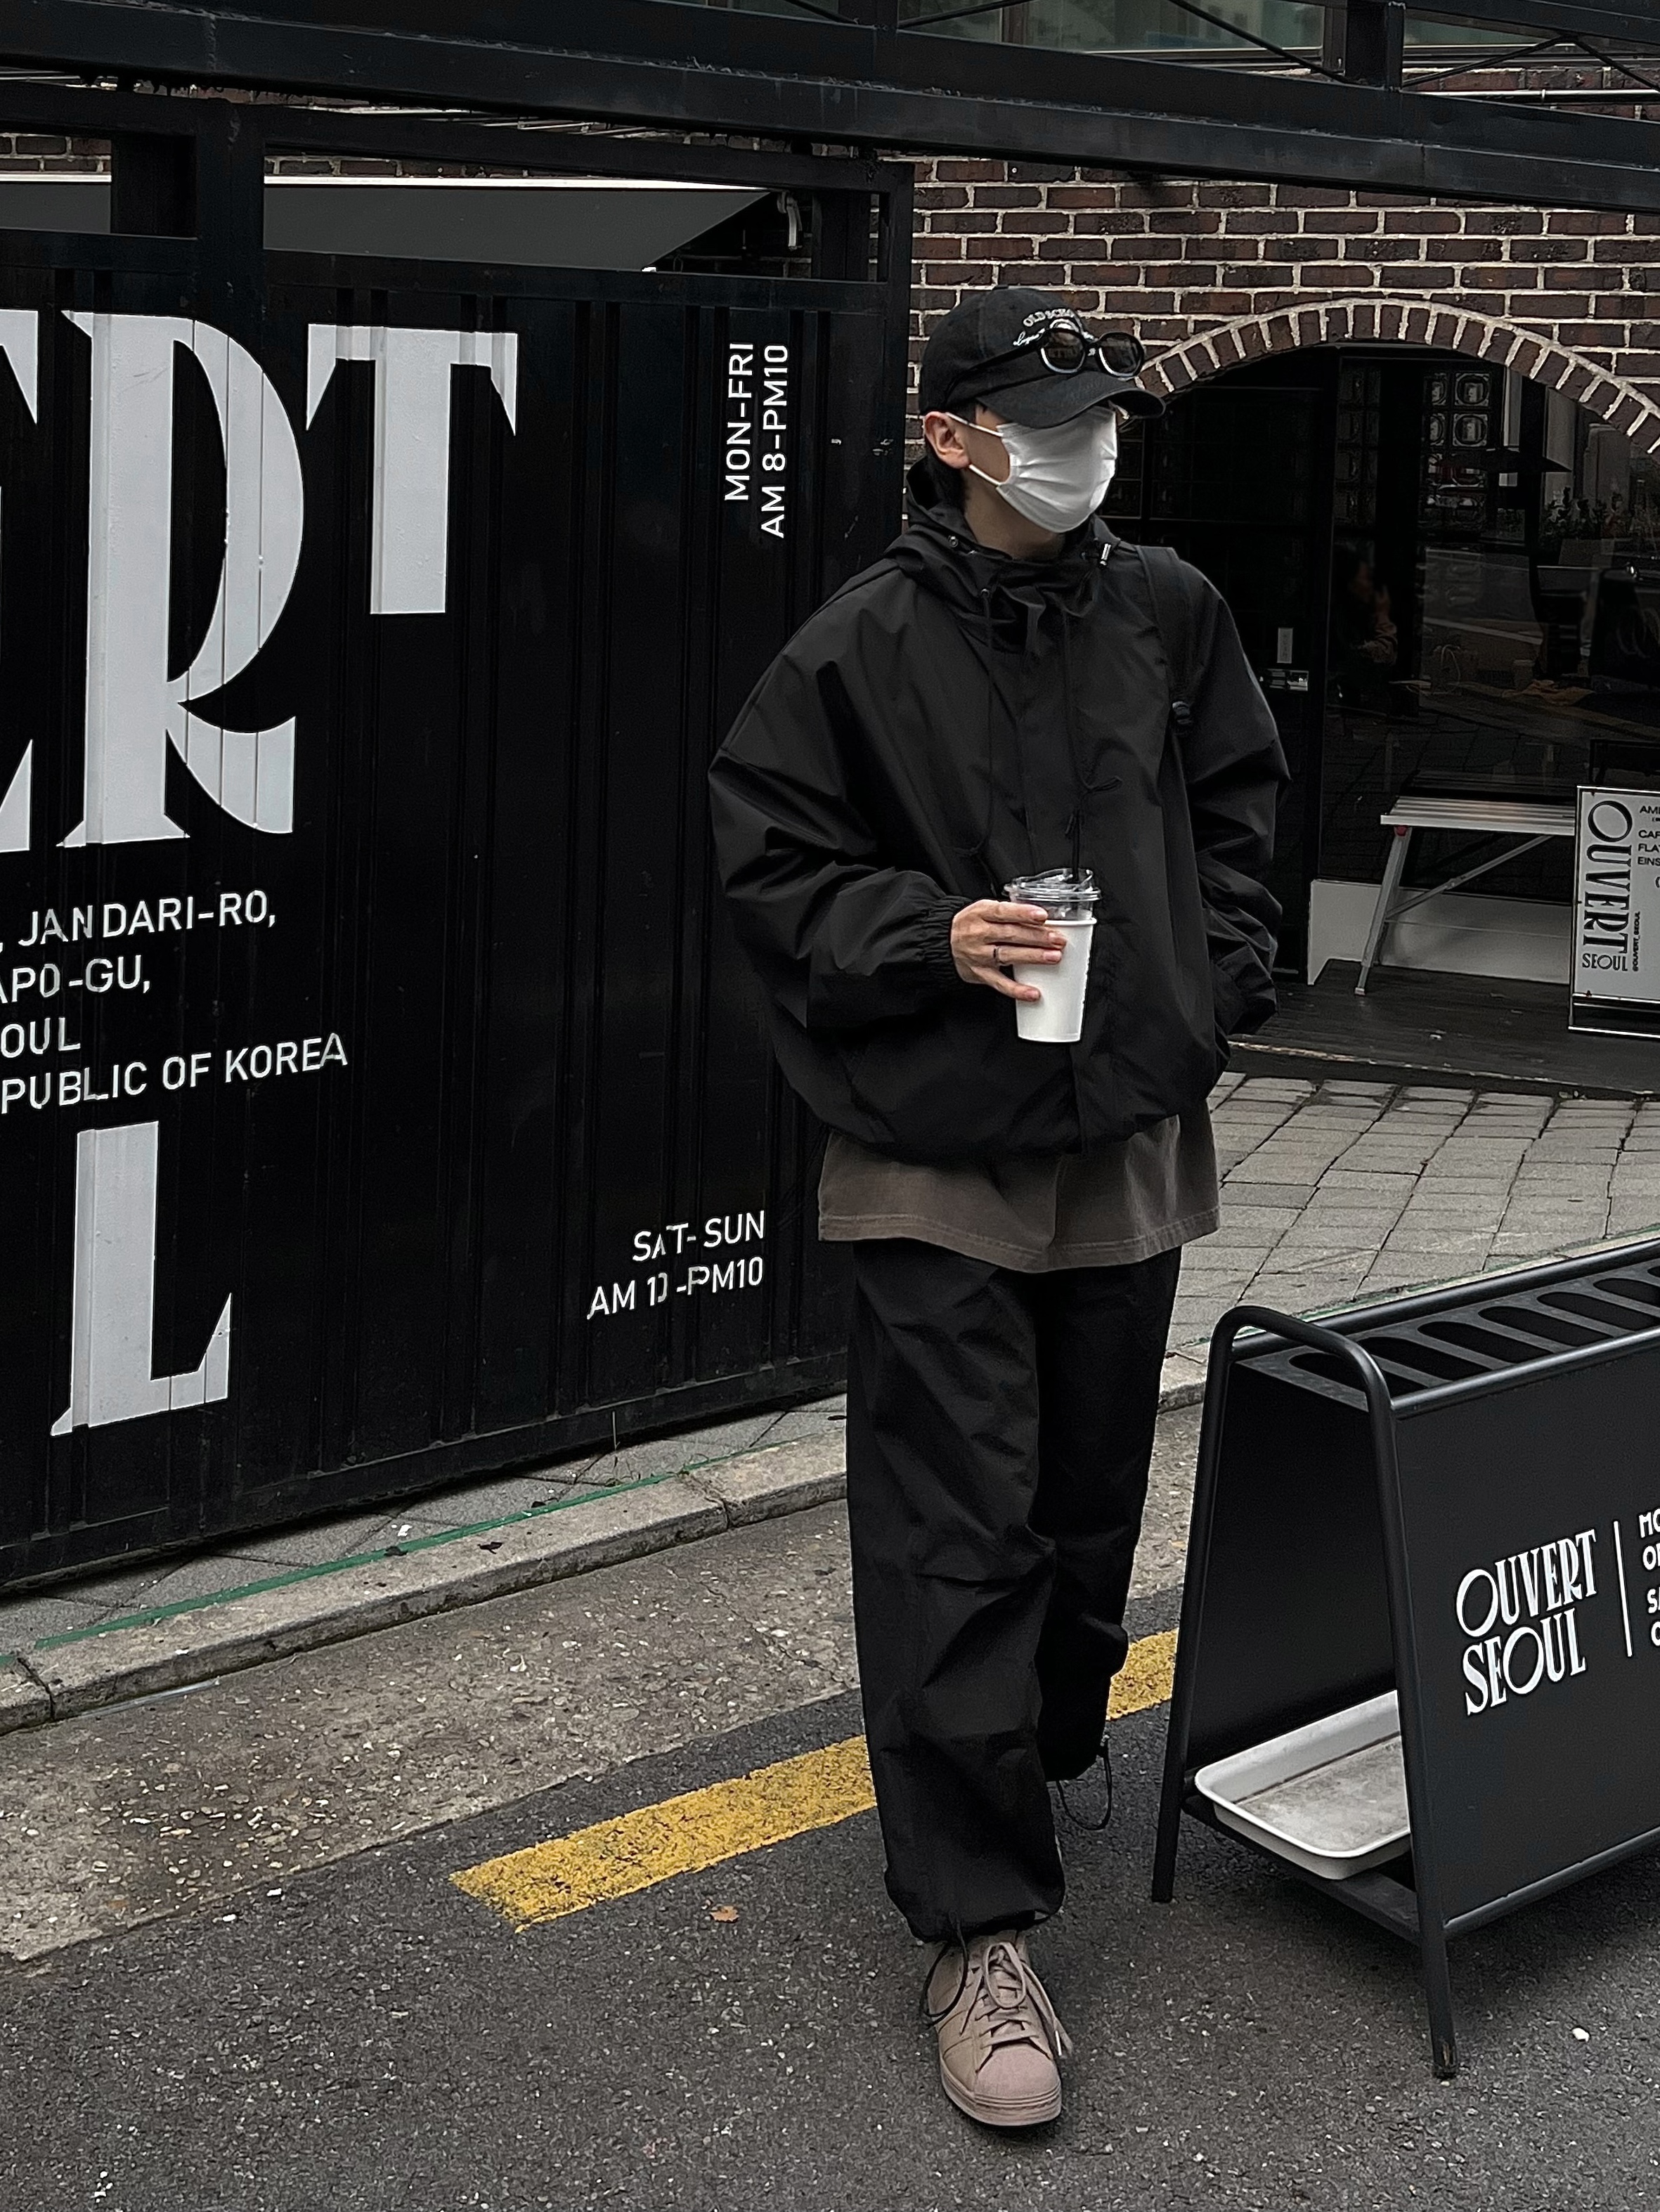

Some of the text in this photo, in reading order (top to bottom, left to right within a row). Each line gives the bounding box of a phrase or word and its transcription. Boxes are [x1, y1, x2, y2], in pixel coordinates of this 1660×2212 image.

[725, 343, 753, 500] MON-FRI
[761, 344, 788, 538] AM 8-PM10
[1638, 843, 1660, 853] FLA
[1640, 806, 1660, 814] AM
[1583, 800, 1633, 953] OUVERT
[1582, 953, 1628, 971] SEOUL
[1, 1033, 348, 1114] PUBLIC OF KOREA
[633, 1210, 765, 1262] SAT-SUN
[586, 1280, 635, 1320] AM
[1456, 1528, 1597, 1637] OUVERT
[1463, 1608, 1586, 1716] SEOUL
